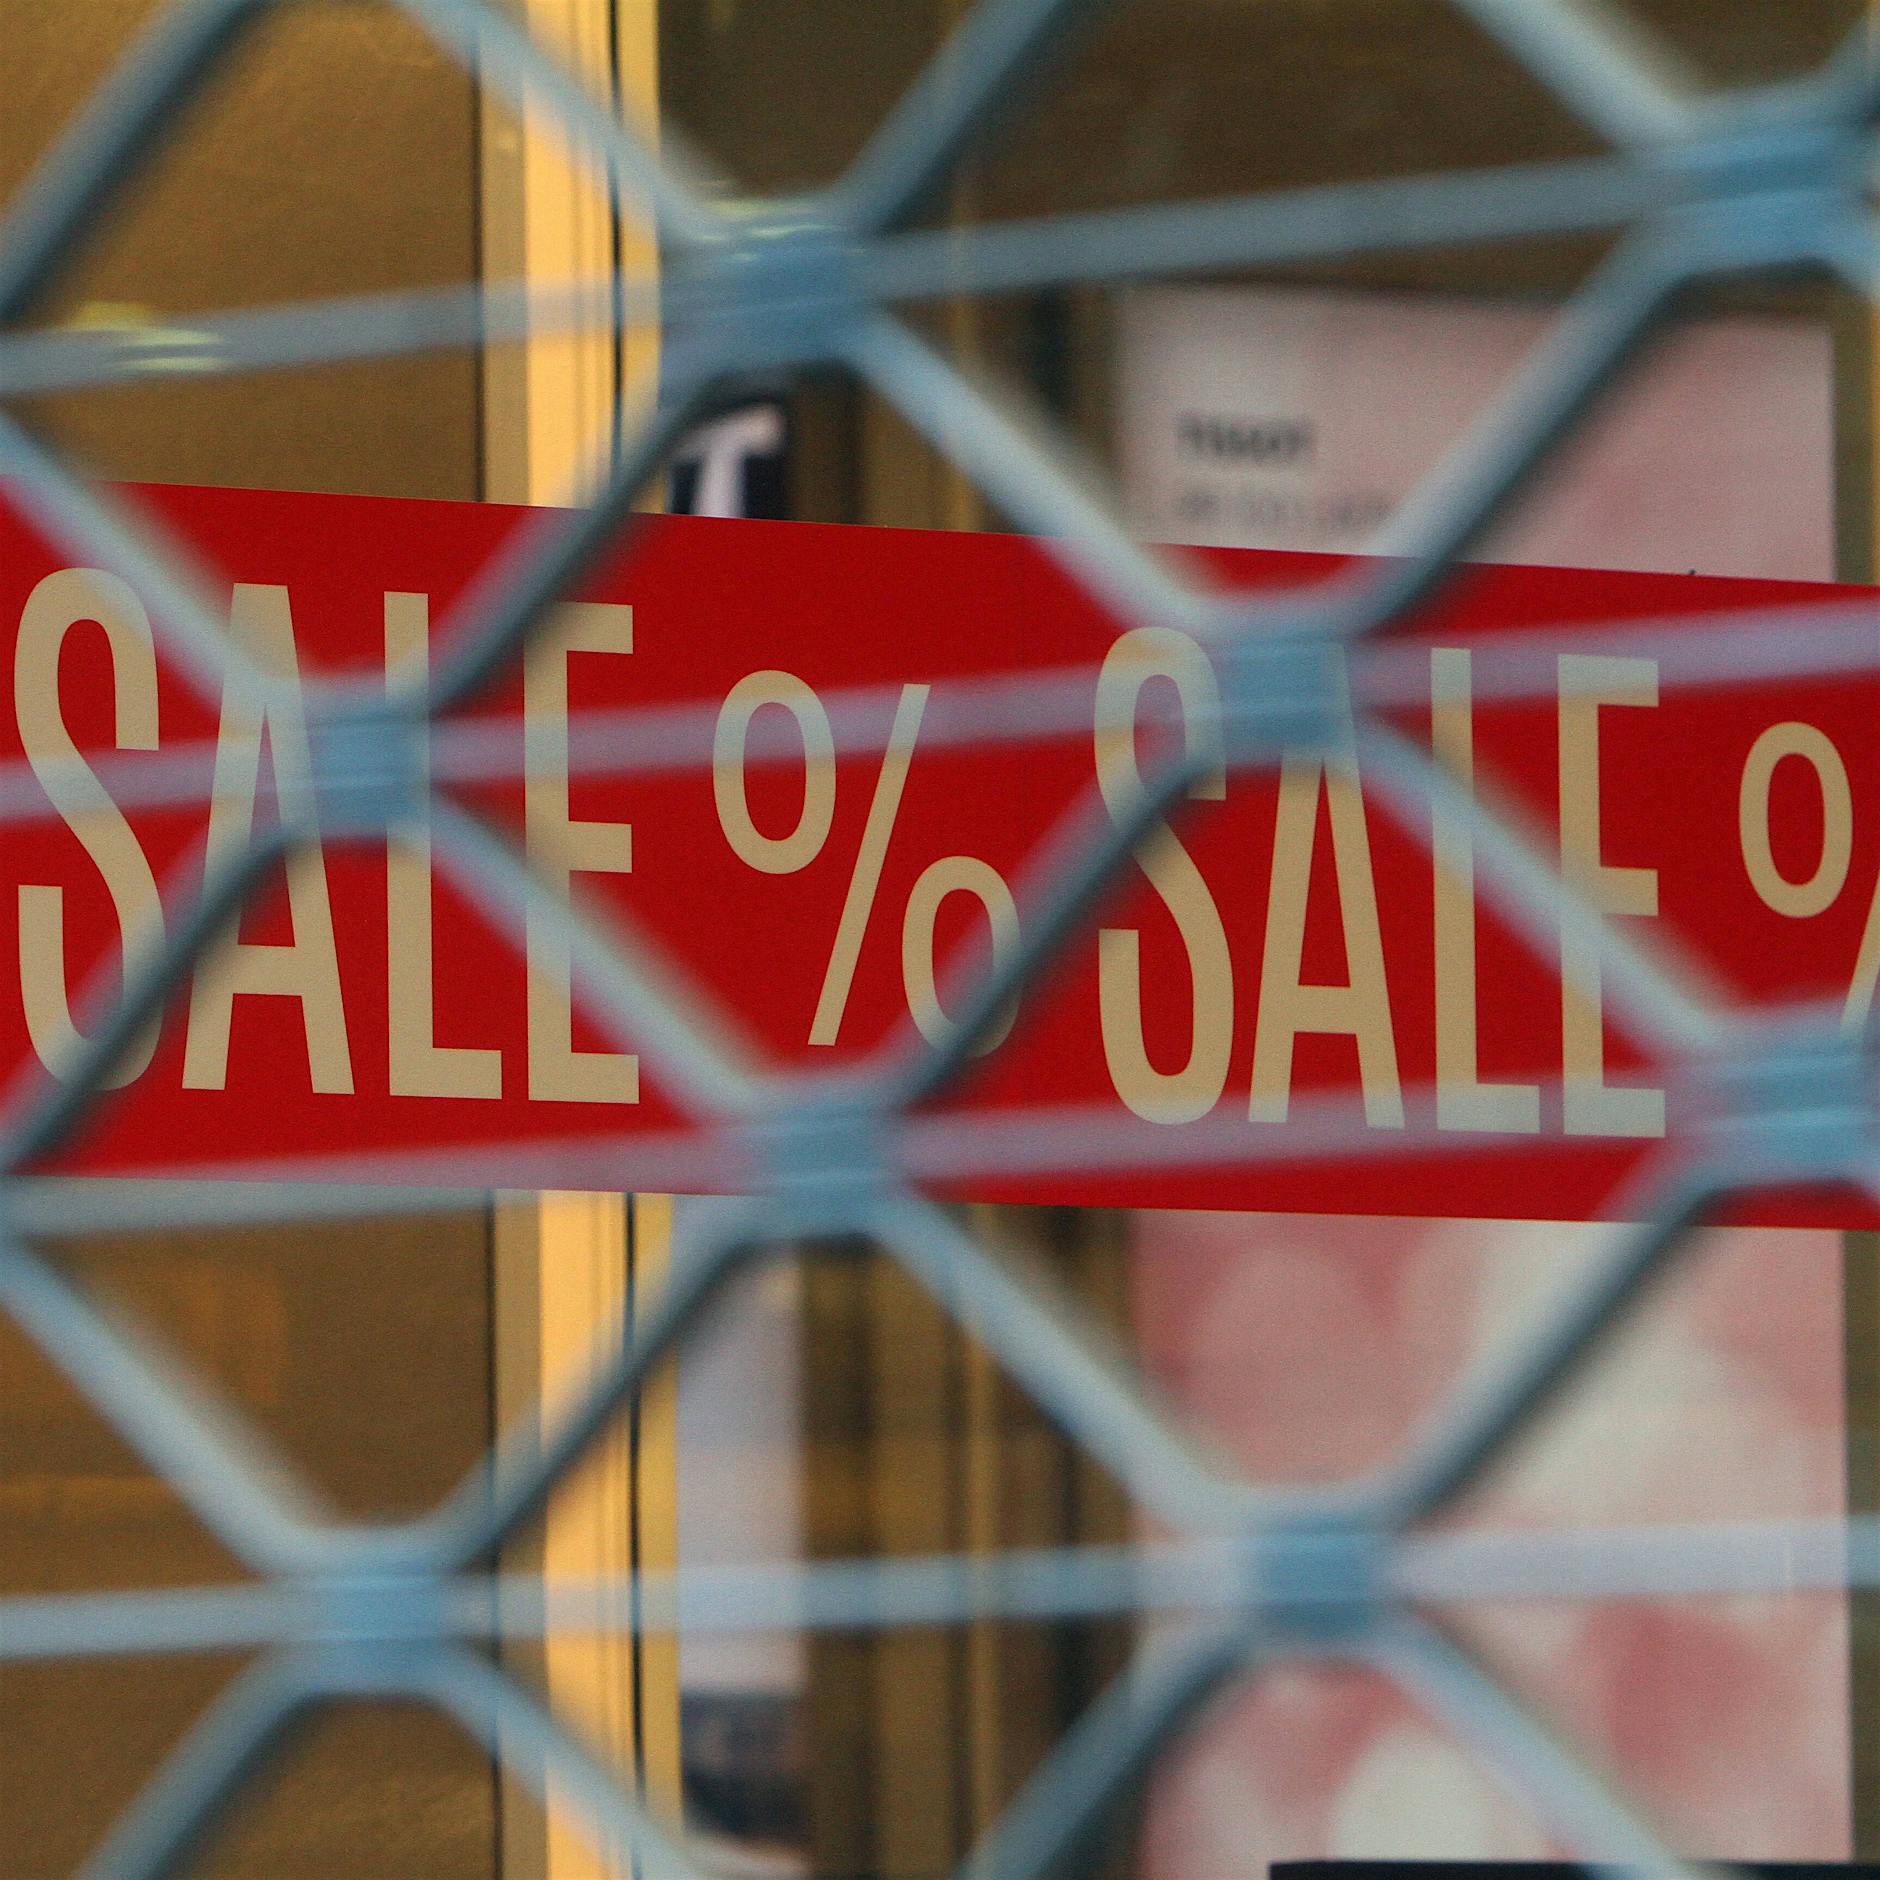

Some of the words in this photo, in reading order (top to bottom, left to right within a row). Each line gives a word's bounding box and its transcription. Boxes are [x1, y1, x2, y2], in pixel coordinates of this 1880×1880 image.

[13, 567, 640, 1104] SALE
[713, 669, 1021, 1057] %
[1094, 626, 1666, 1139] SALE
